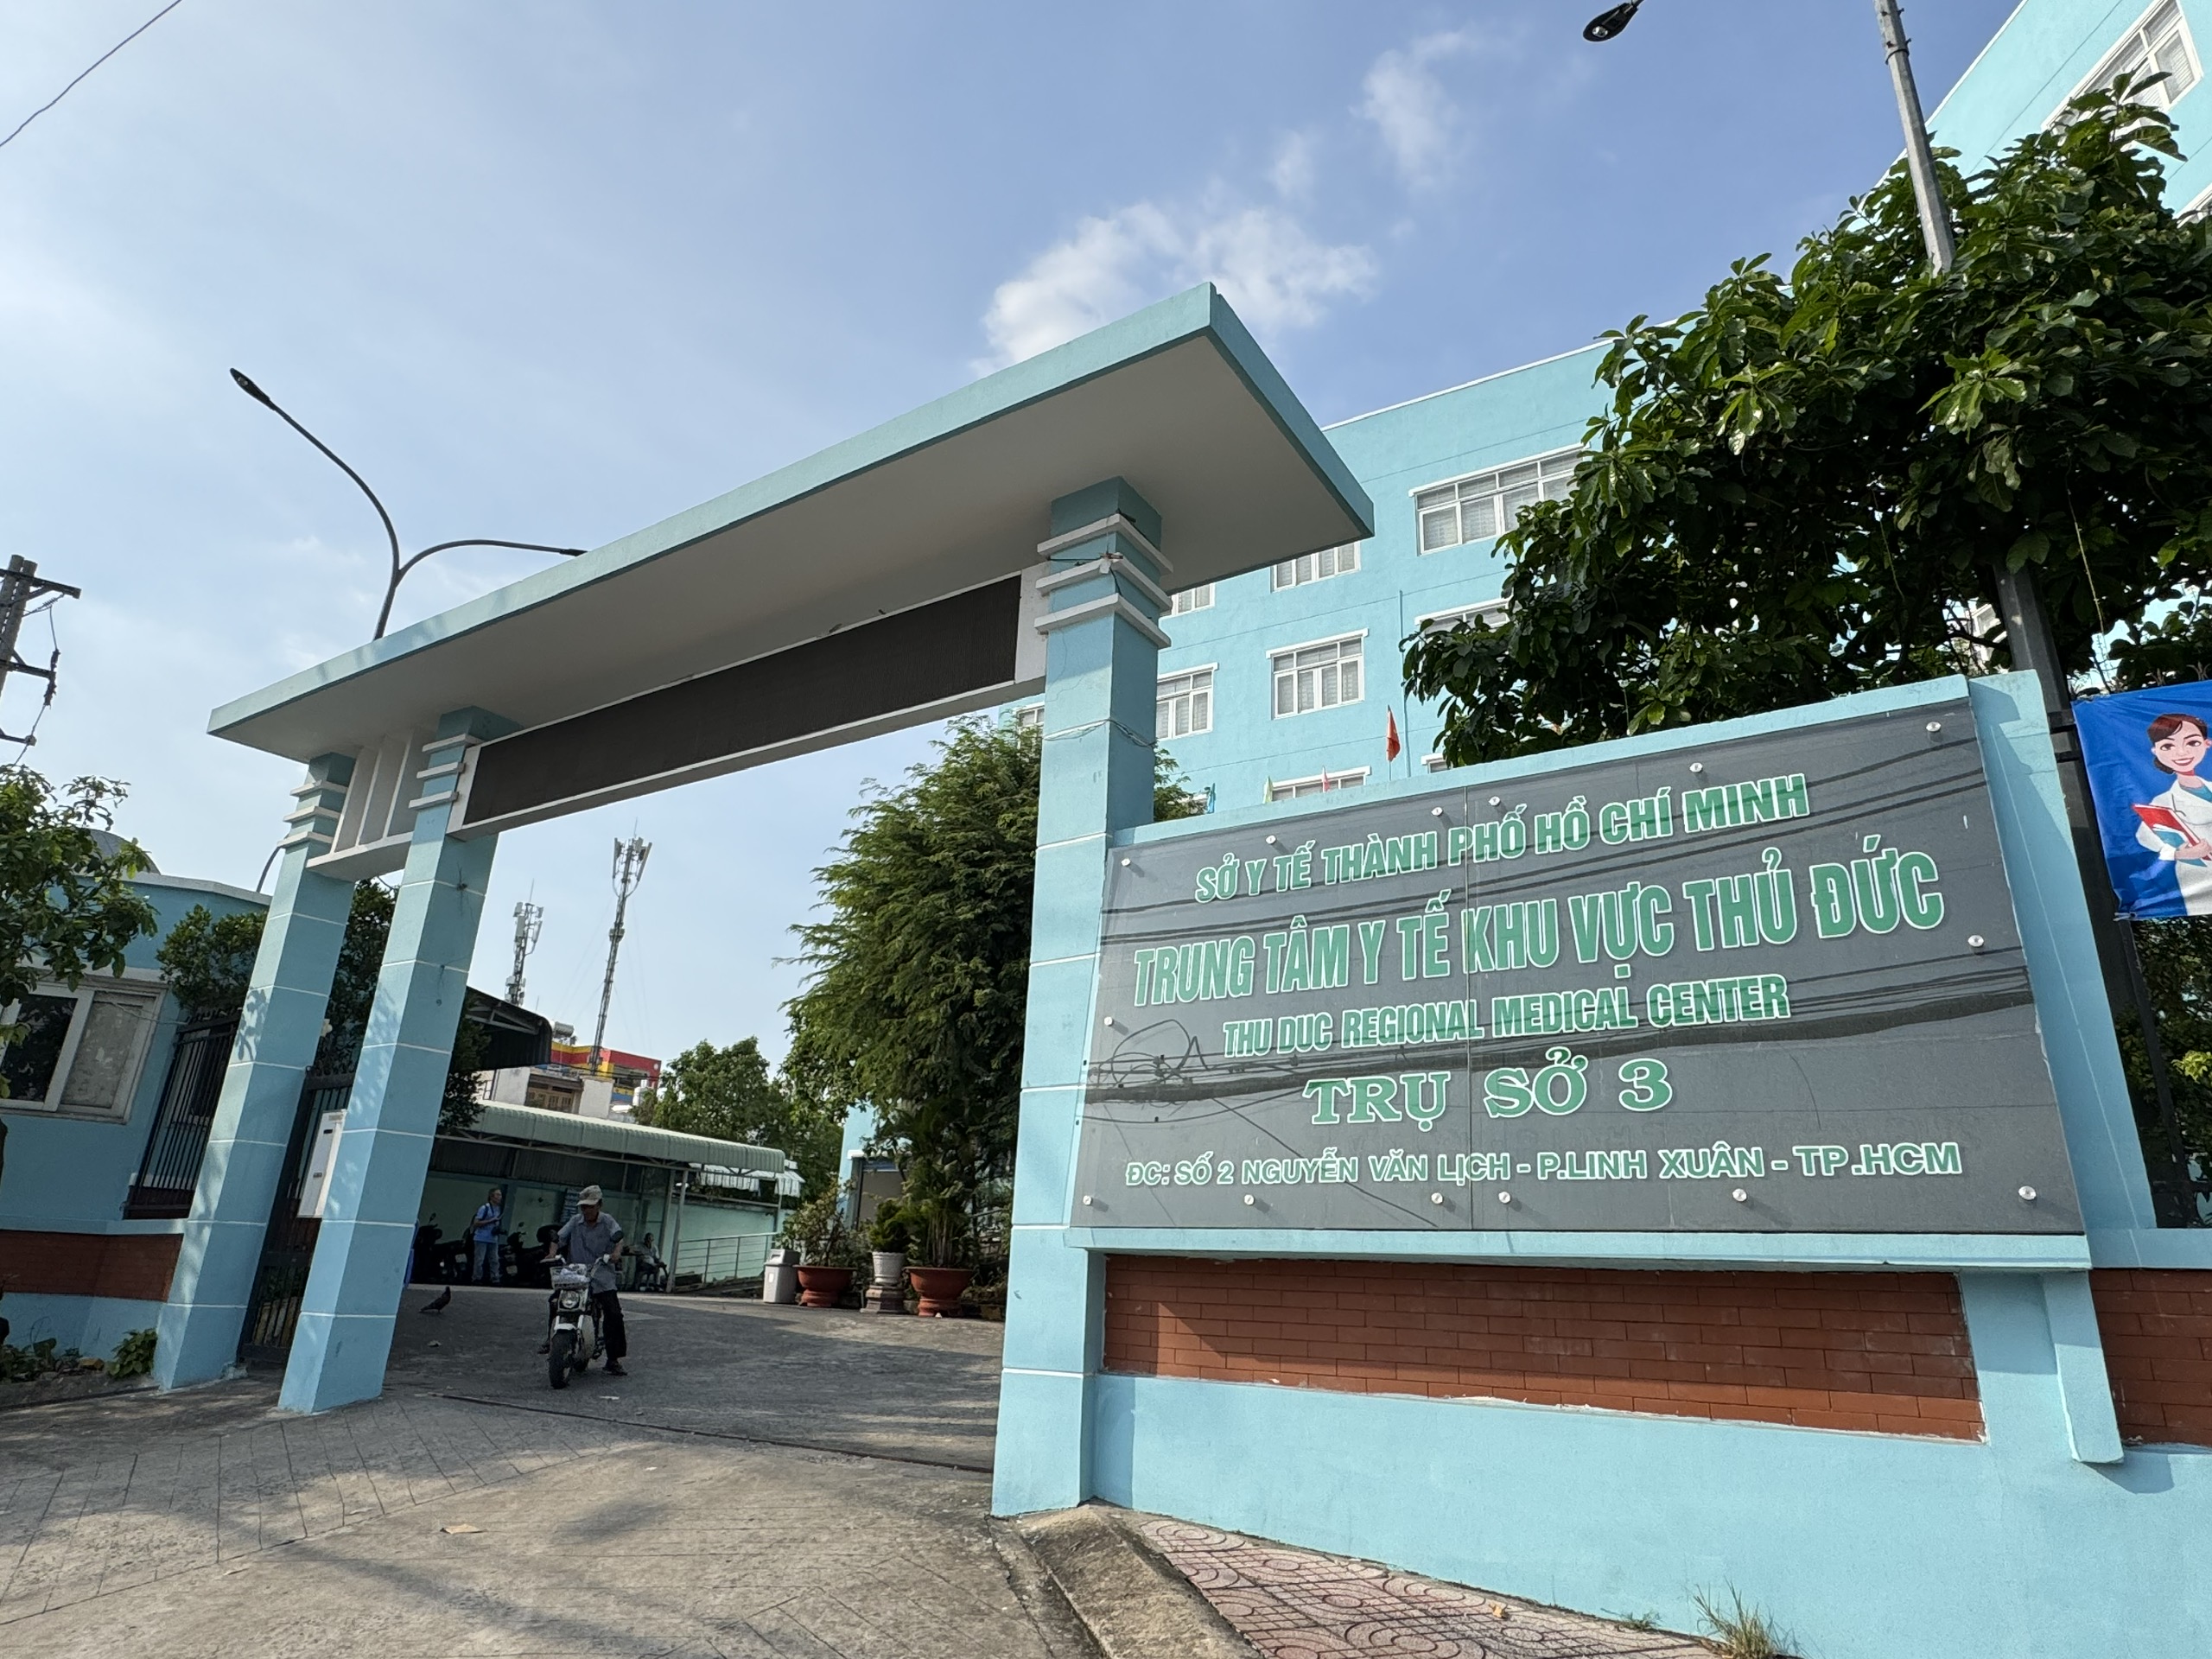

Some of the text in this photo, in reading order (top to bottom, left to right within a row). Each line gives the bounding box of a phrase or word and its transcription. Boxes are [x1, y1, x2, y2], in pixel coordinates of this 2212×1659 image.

[1195, 773, 1810, 903] SỞ Y TẾ THÀNH PHỐ HỒ CHÍ MINH
[1134, 834, 1945, 1007] TRUNG TÂM Y TẾ KHU VỰC THỦ ĐỨC
[1224, 974, 1791, 1058] THU DUC REGIONAL MEDICAL CENTER
[1302, 1046, 1673, 1132] TRỤ SỞ 3
[1125, 1160, 1170, 1186] ĐC:
[1174, 1151, 1213, 1185] SỐ
[1217, 1160, 1234, 1185] 2
[1241, 1147, 1358, 1185] NGUYỄN
[1368, 1149, 1428, 1182] VĂN
[1437, 1152, 1511, 1186] LỊCH
[1659, 1141, 1765, 1179] XUÂN
[1792, 1141, 1962, 1177] TP.HCM
